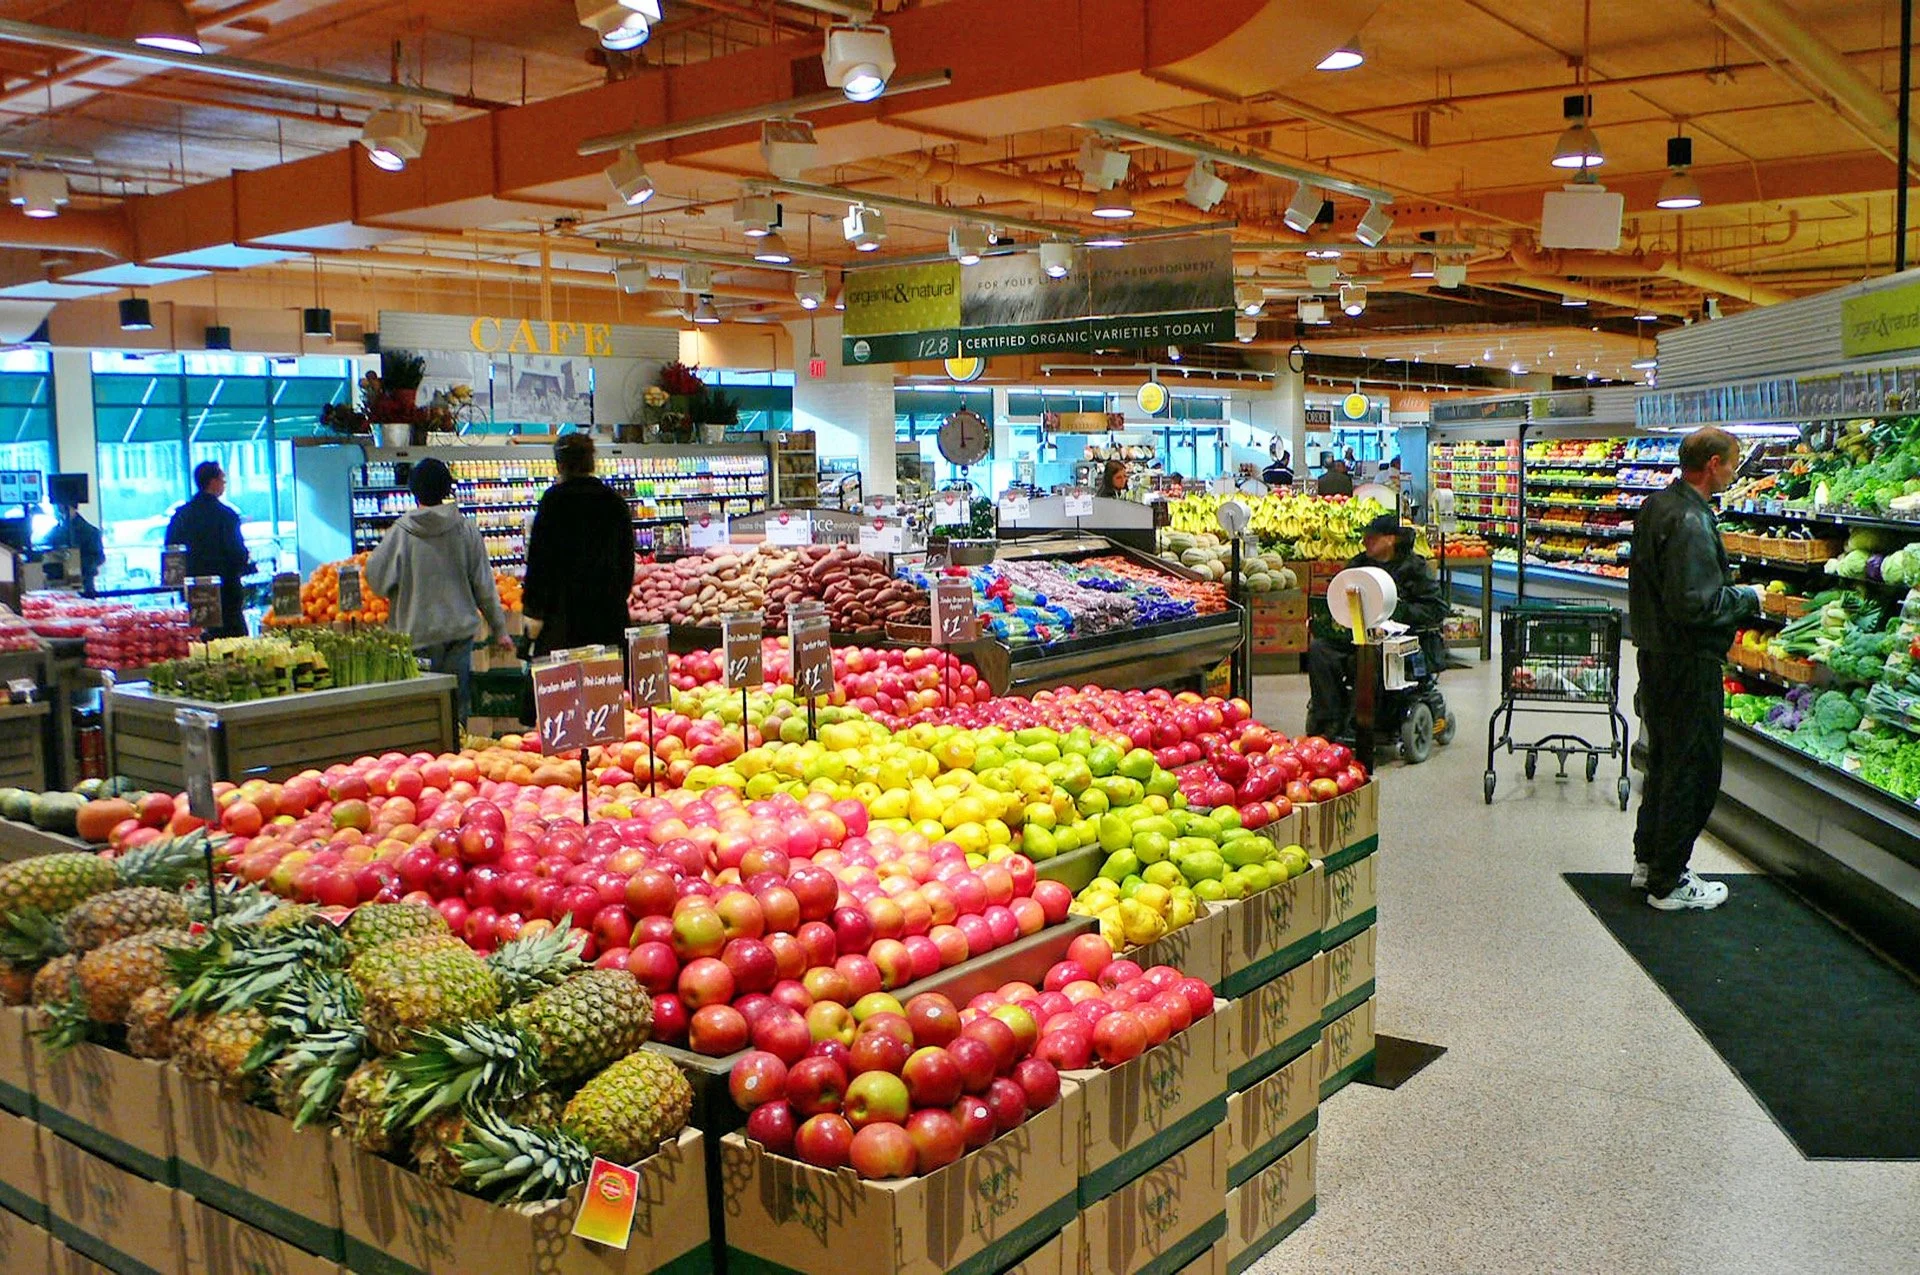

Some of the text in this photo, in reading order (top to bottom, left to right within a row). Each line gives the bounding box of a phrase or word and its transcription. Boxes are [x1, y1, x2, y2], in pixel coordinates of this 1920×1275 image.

[977, 281, 999, 291] FOR
[1004, 278, 1033, 288] YOUR
[470, 315, 613, 356] CAFE
[918, 322, 1215, 357] 128 CERTIFIED ORGANIC VARIETIES TODAY!
